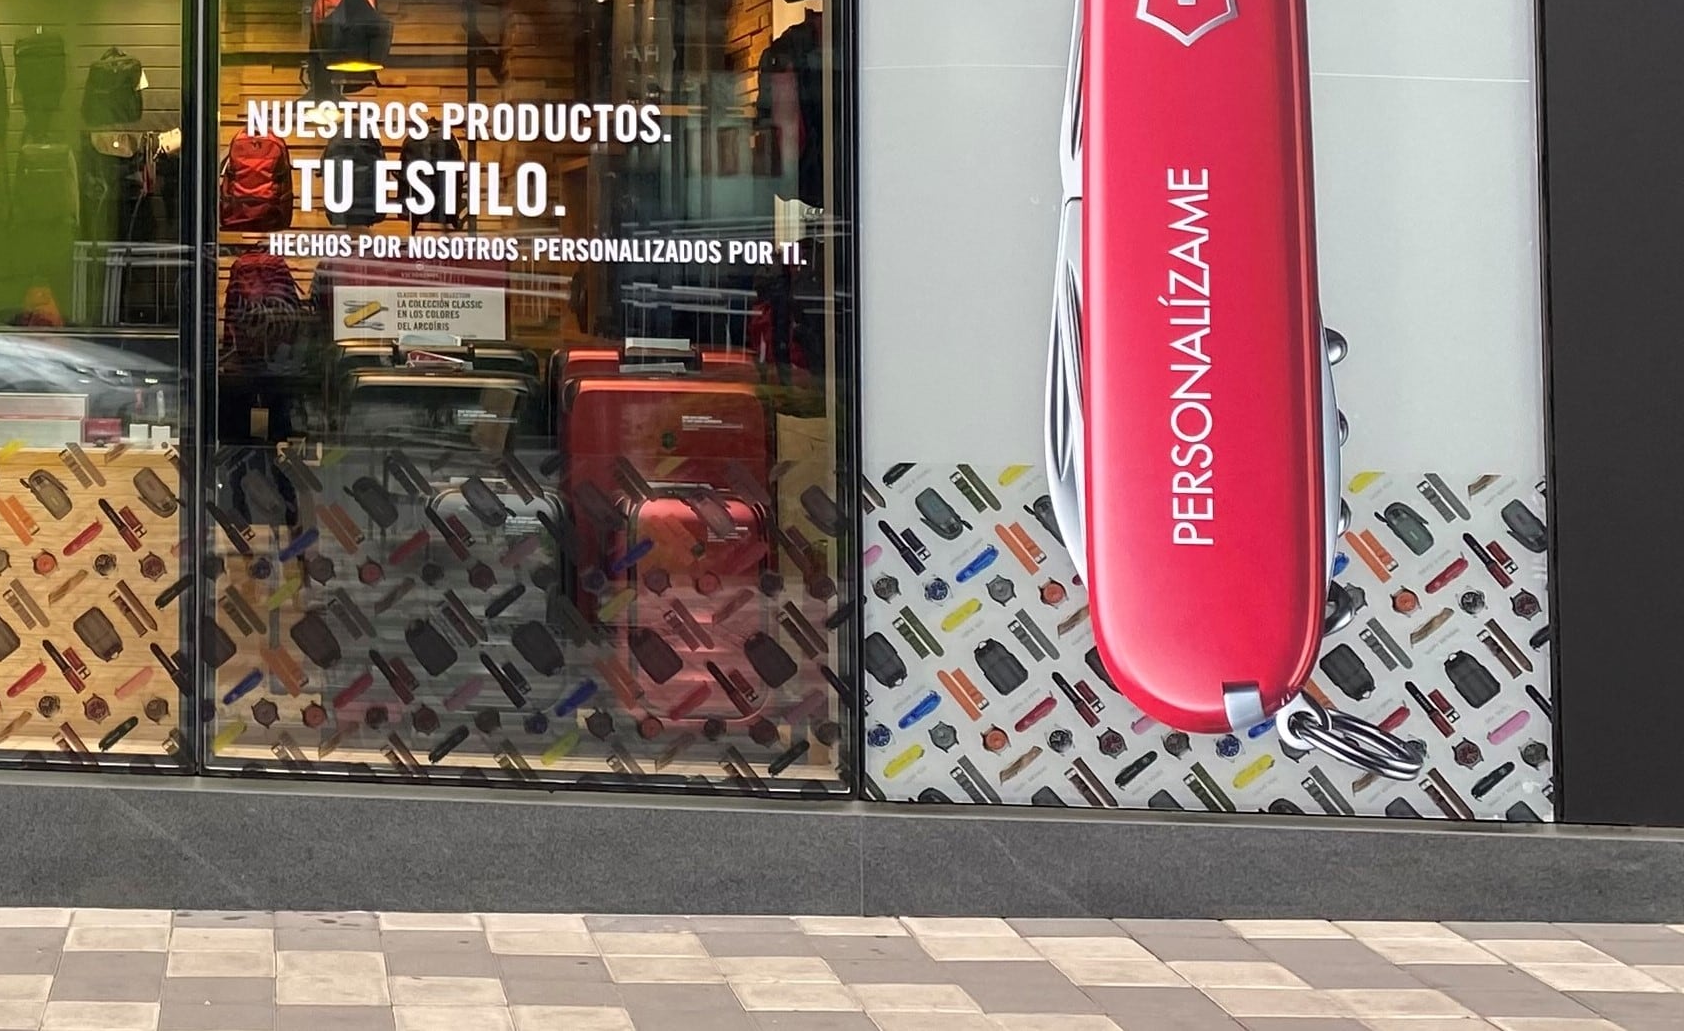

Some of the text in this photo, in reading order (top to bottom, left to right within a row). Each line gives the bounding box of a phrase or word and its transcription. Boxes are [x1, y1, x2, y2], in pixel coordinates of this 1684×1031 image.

[247, 100, 671, 143] NUESTROS PRODUCTOS.
[292, 159, 566, 217] TU ESTILO.
[269, 233, 807, 266] HECHOS POR NOSOTROS. PERSONALIZADOS POR TI.
[397, 300, 406, 308] LA
[452, 300, 483, 308] CLASSIC
[397, 310, 460, 319] EN LOS COLORES
[397, 322, 411, 330] DEL
[1157, 168, 1214, 545] PERSONALÍZAME
